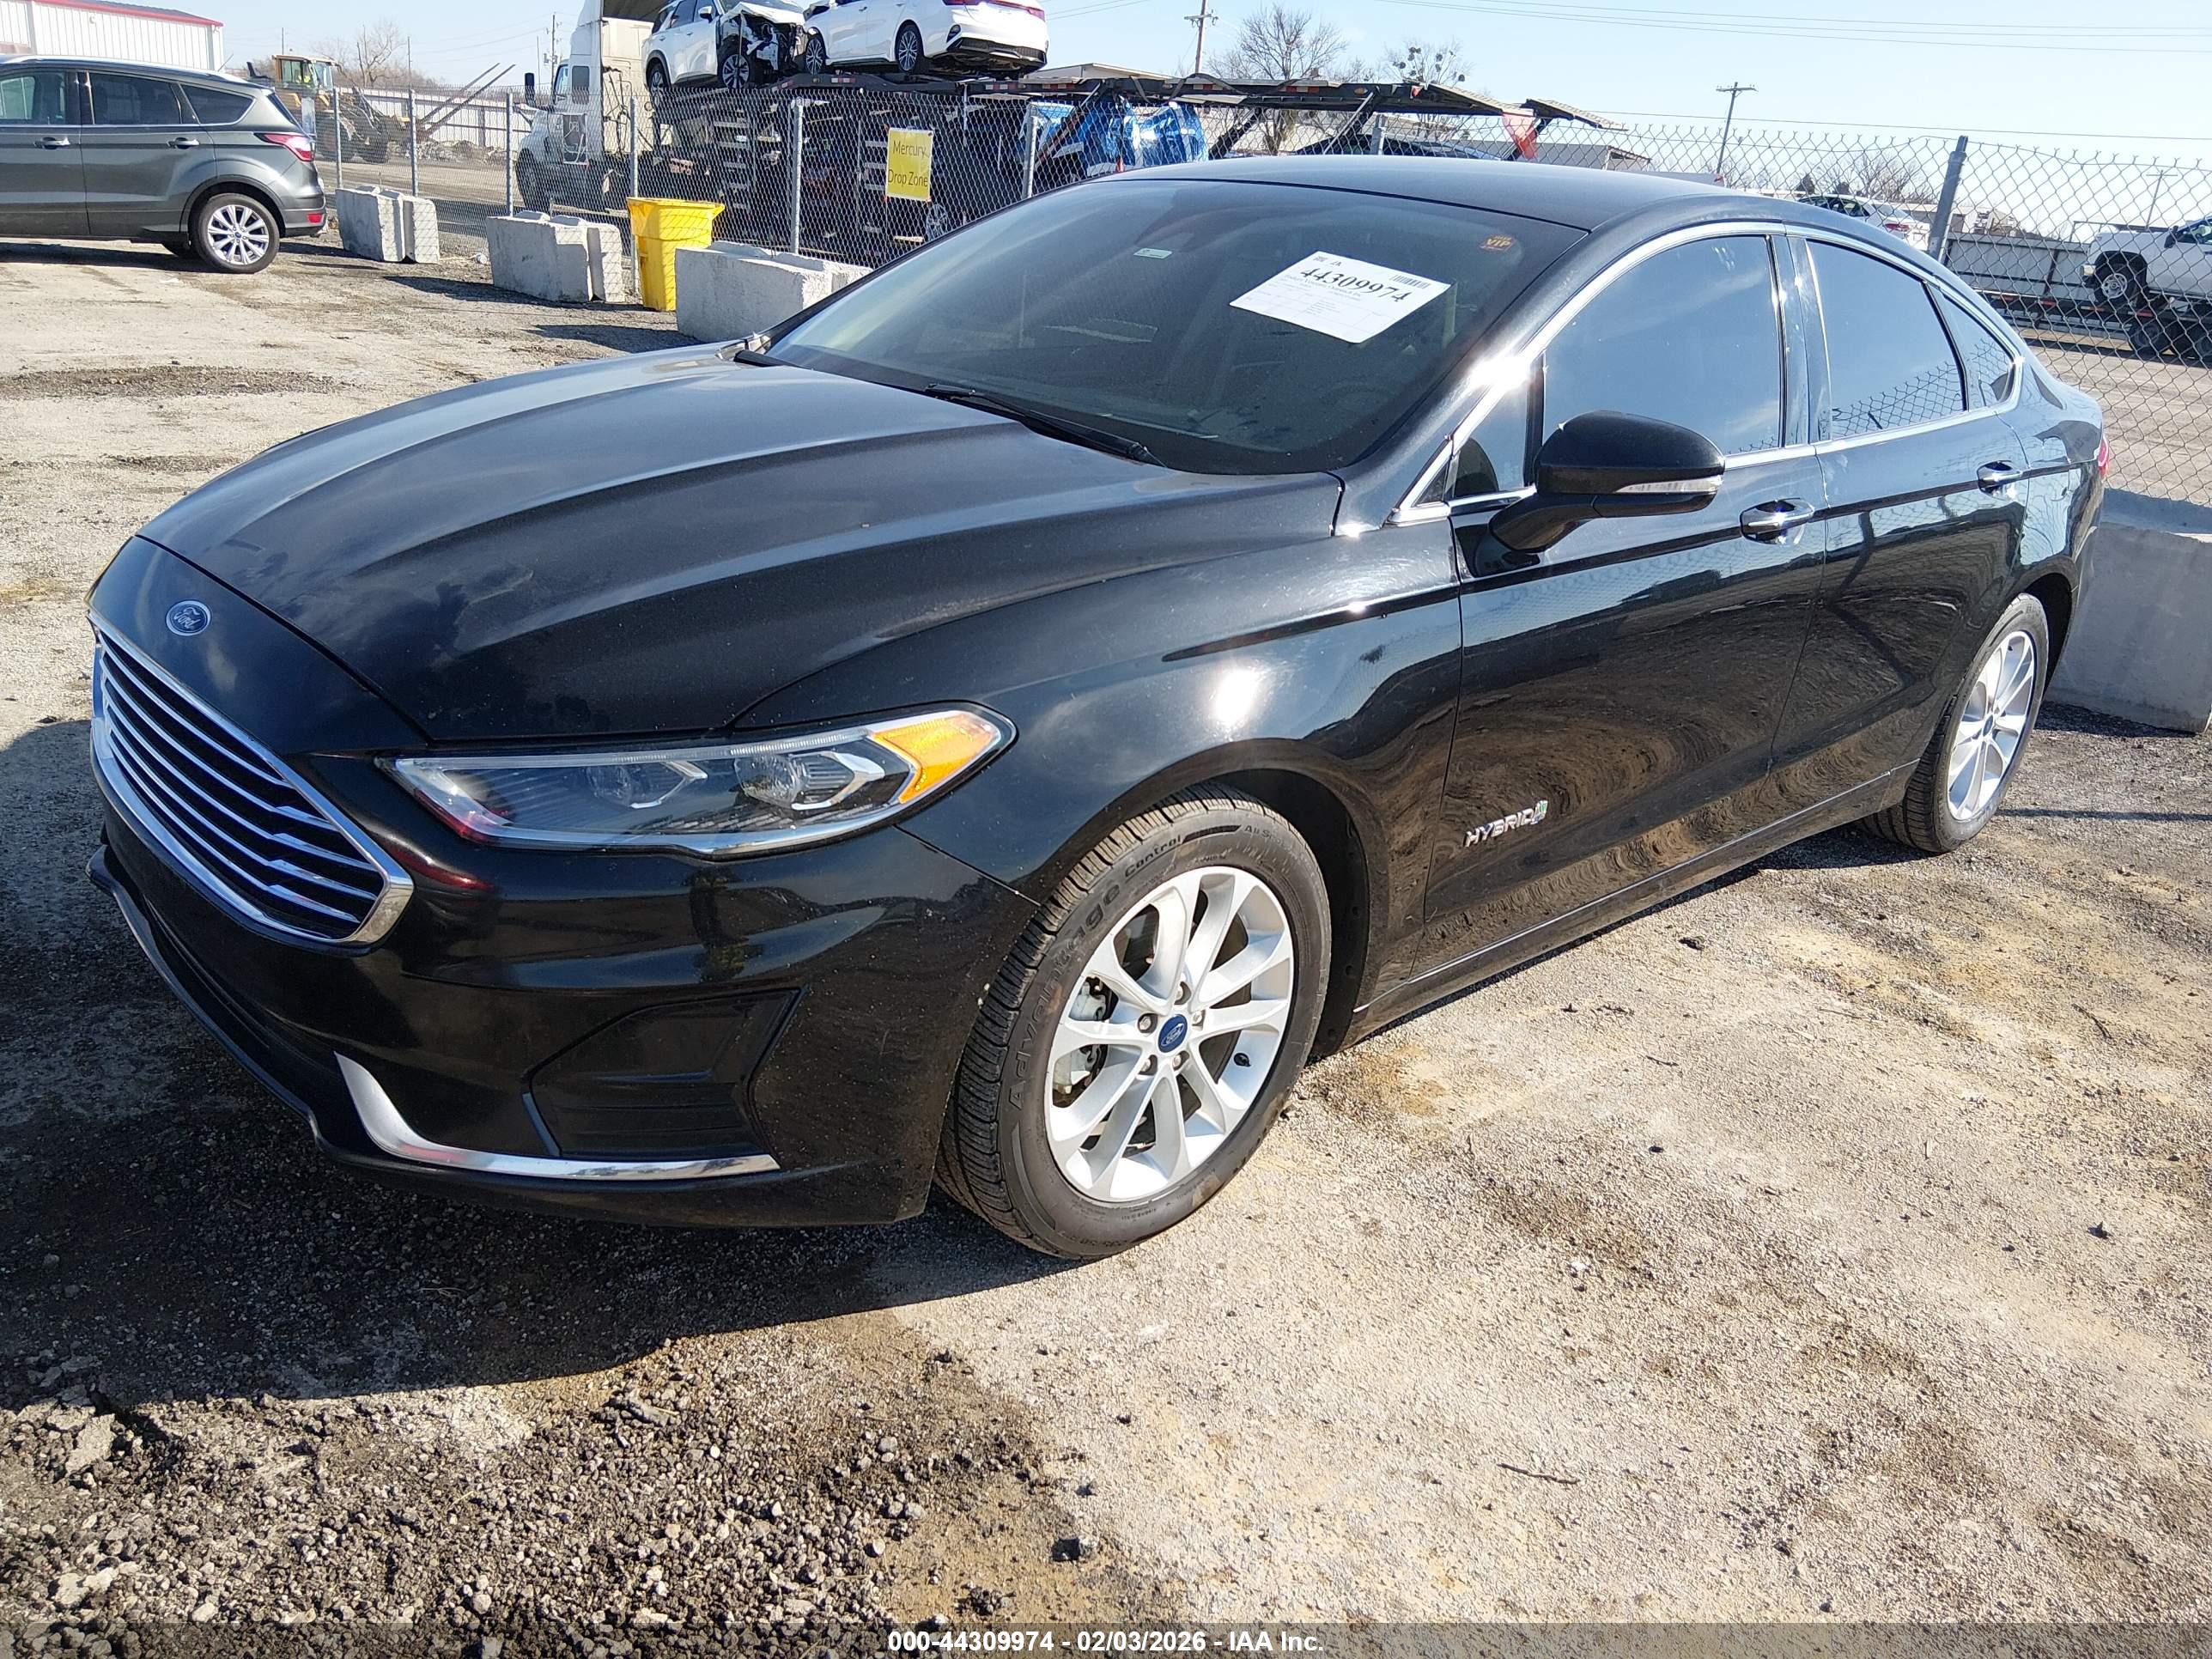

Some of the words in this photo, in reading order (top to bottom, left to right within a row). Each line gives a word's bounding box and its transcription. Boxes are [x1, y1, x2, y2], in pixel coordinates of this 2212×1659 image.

[892, 140, 927, 160] Mercury
[888, 169, 907, 186] Drop
[908, 172, 928, 187] Zone
[1486, 238, 1511, 247] VIP
[1299, 267, 1413, 302] 44309974
[1463, 807, 1534, 848] HYBRID
[1124, 835, 1182, 878] Control
